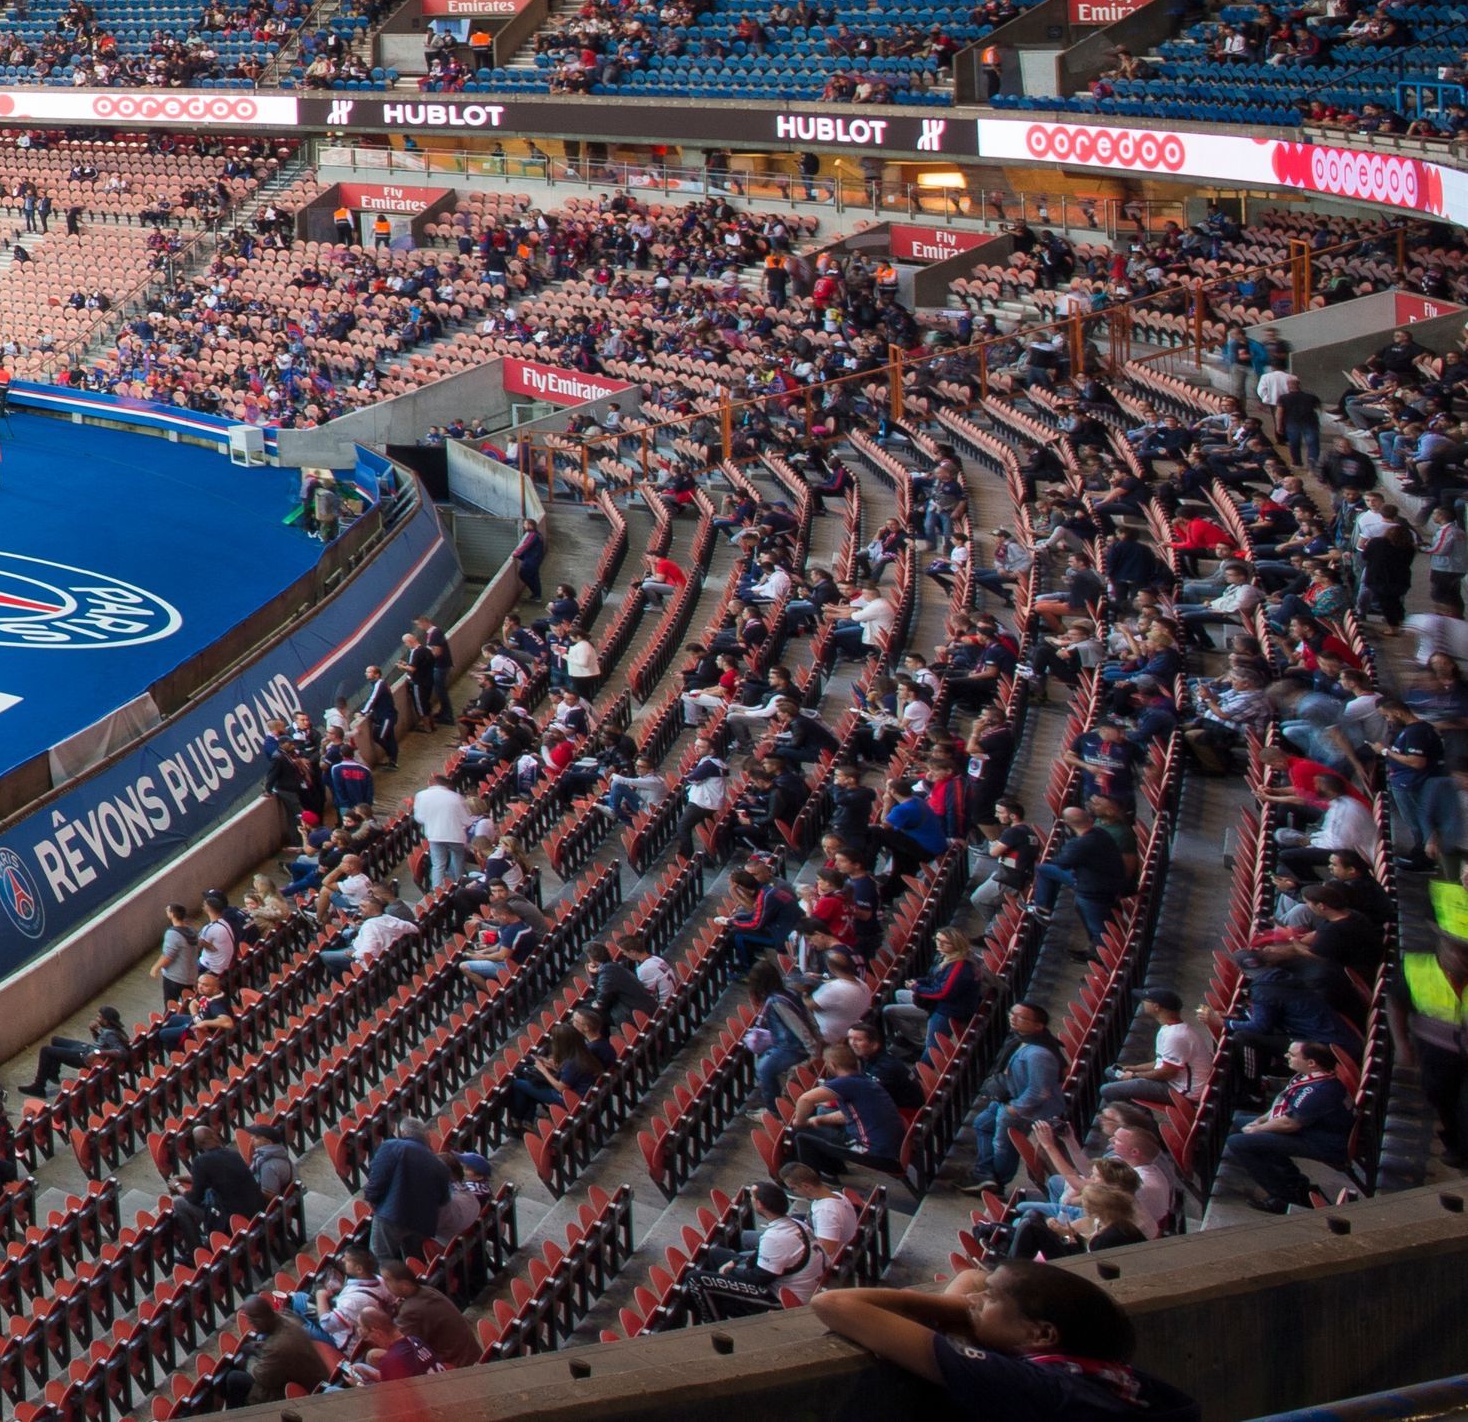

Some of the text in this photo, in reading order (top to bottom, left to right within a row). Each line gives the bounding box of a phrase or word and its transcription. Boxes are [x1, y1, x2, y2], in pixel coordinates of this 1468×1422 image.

[448, 0, 515, 12] Emirates
[95, 96, 255, 120] ooredoo
[383, 104, 504, 126] HUBLOT
[777, 115, 887, 144] HUBLOT
[1028, 126, 1184, 169] ooredoo
[1313, 150, 1416, 204] ooredoo
[361, 195, 427, 212] Emirates
[383, 186, 403, 198] Fly
[936, 231, 956, 247] Fly
[1424, 302, 1437, 318] Fly
[522, 366, 546, 393] Fly
[33, 673, 301, 904] RÊVONS PLUS GRAND
